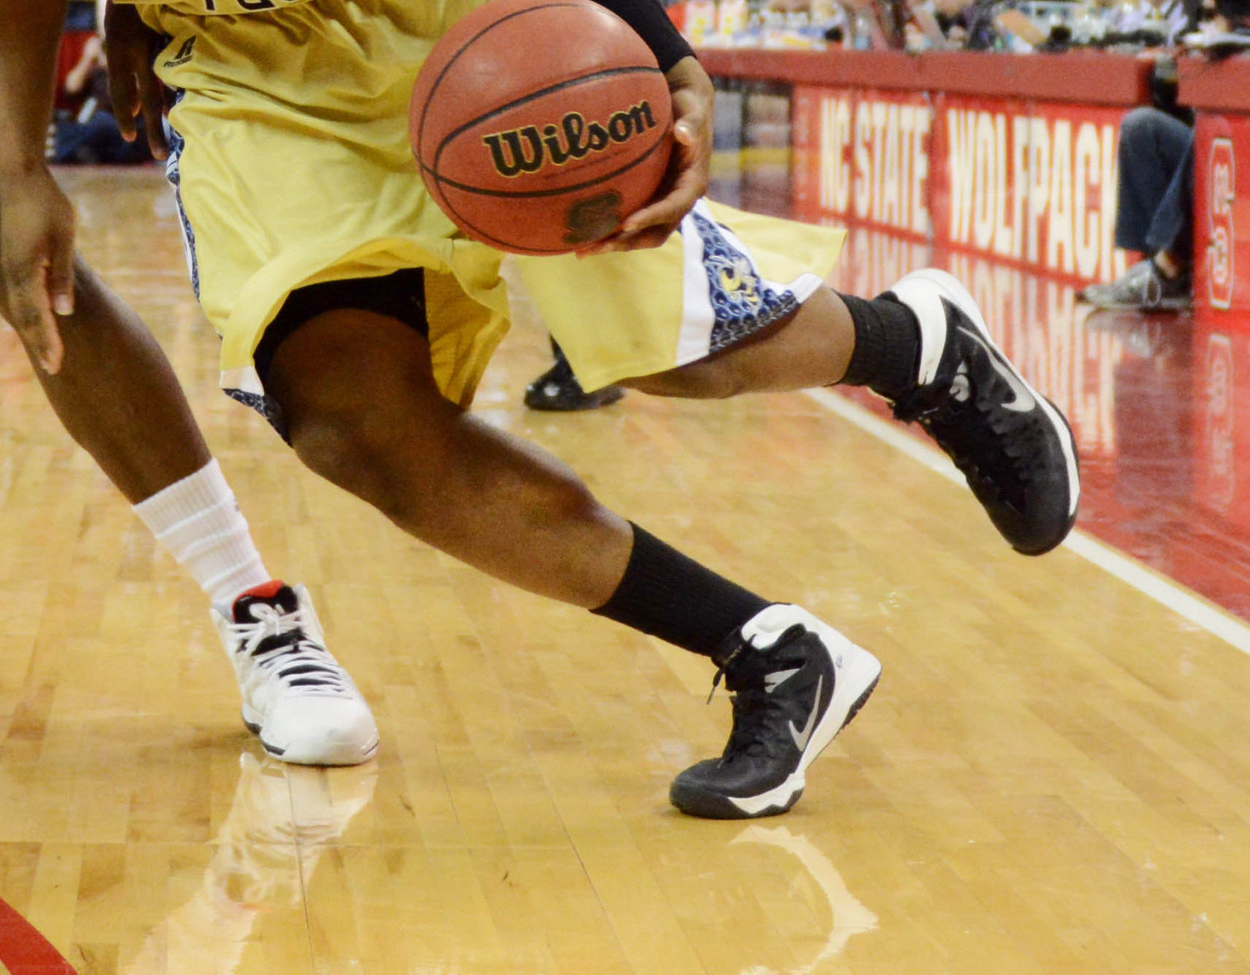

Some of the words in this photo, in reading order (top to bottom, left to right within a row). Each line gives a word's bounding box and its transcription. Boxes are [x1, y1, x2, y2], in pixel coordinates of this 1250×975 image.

[482, 100, 656, 178] Wilson
[820, 98, 850, 213] NC
[854, 100, 929, 235] STATE
